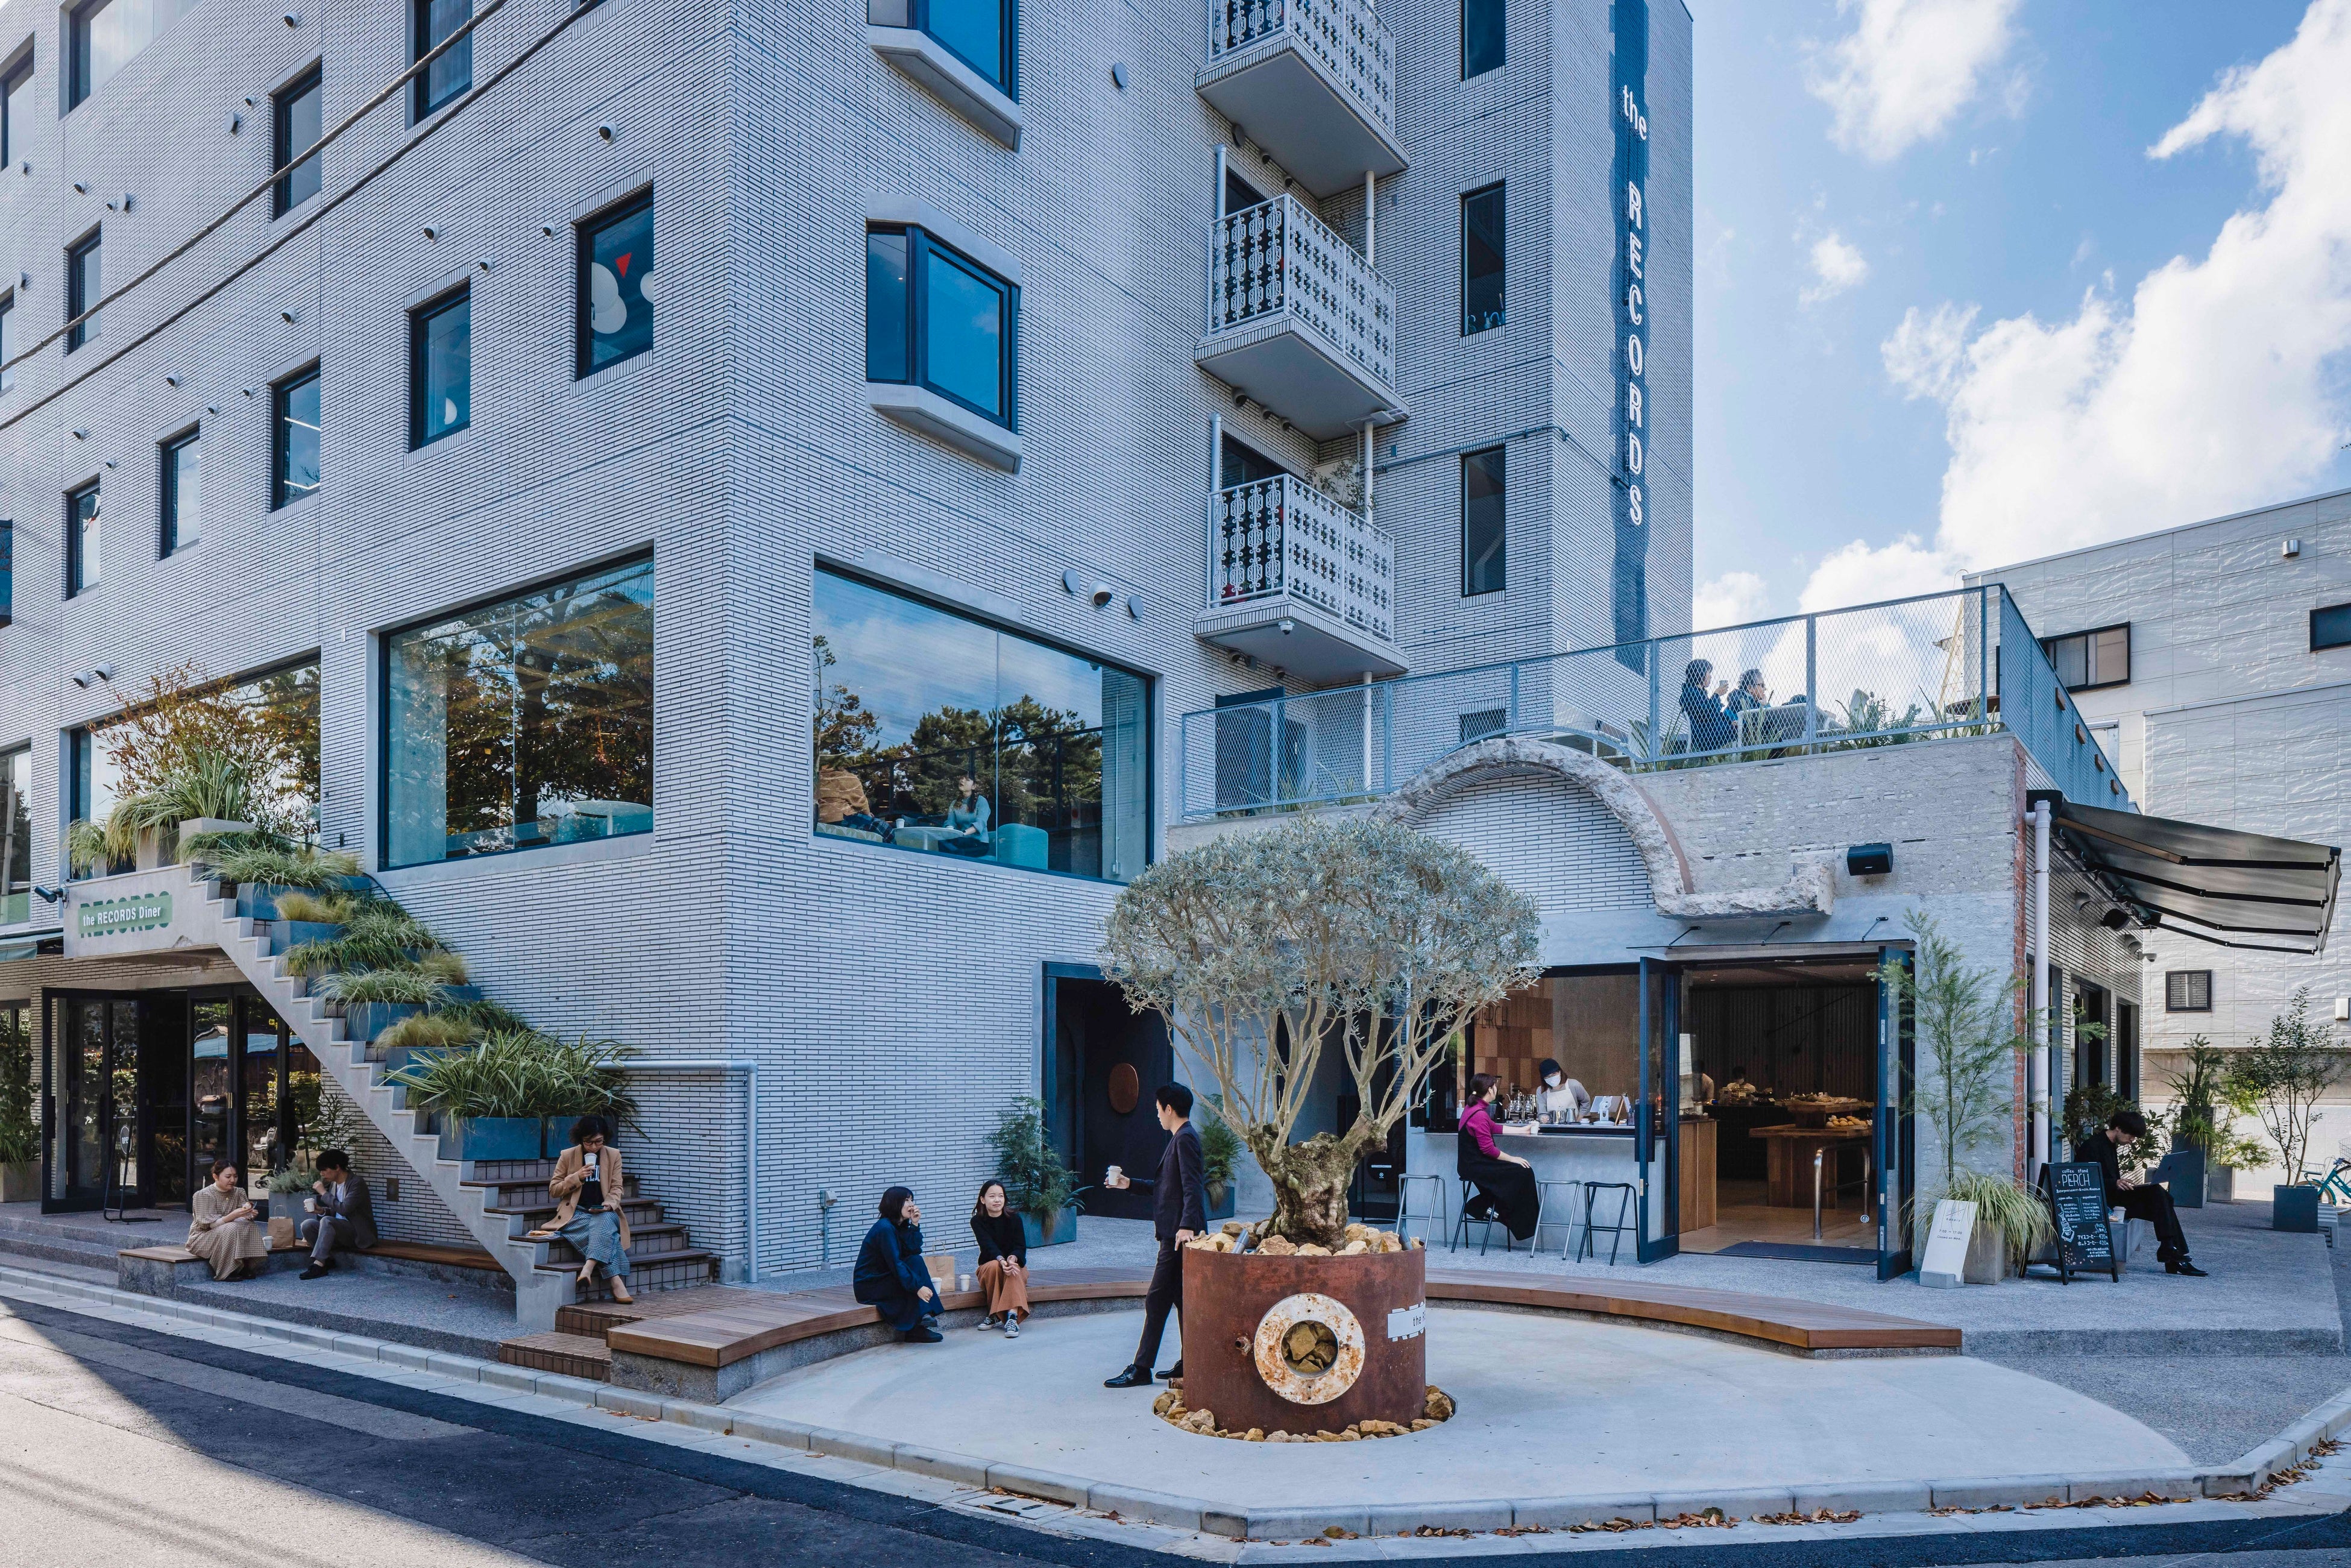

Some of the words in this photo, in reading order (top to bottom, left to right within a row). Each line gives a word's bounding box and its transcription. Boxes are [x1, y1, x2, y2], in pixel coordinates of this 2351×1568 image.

[1622, 84, 1647, 140] the
[1628, 181, 1643, 526] RECORDS
[83, 915, 95, 927] the
[98, 907, 136, 924] RECORDS
[139, 905, 162, 919] Diner
[2062, 1173, 2090, 1186] PERCH
[1413, 1315, 1421, 1327] the
